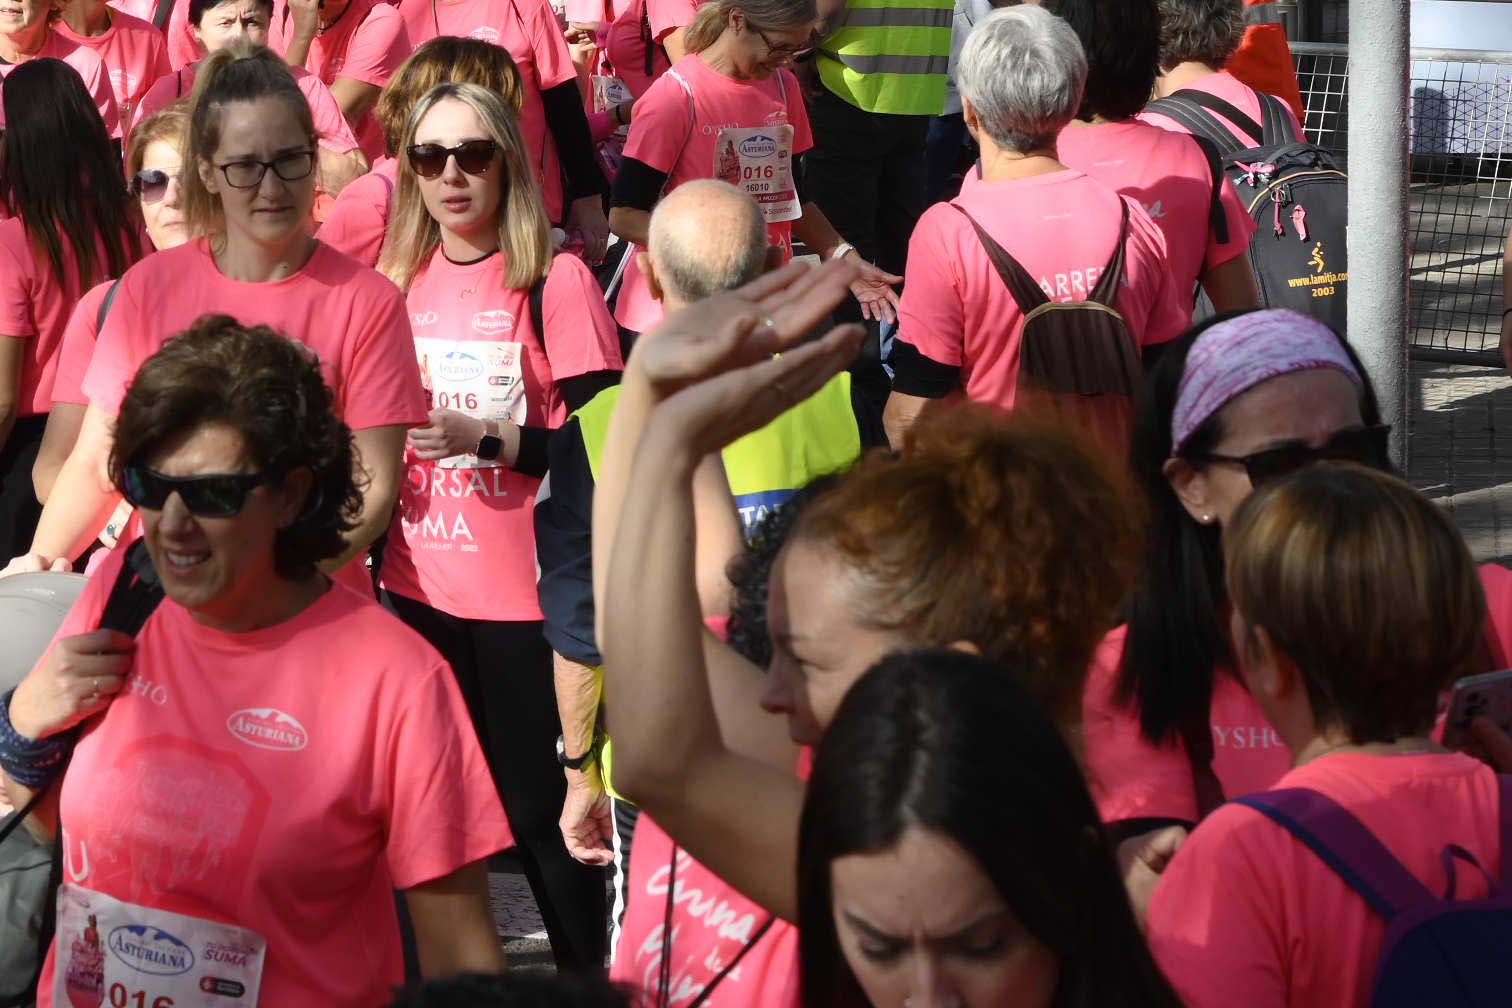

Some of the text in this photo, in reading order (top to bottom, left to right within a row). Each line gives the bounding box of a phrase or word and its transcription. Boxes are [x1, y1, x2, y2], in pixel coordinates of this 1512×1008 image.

[742, 143, 775, 153] ASTURIANA
[743, 165, 774, 180] 016
[745, 183, 770, 192] 16010
[1287, 272, 1348, 288] www.lamitja.co
[1311, 287, 1335, 297] 2003
[438, 392, 478, 410] 016
[407, 465, 508, 497] ORSAL
[401, 511, 473, 541] UMA
[235, 720, 300, 746] ASTURIANA
[1213, 725, 1285, 750] YSH
[114, 933, 186, 970] ASTURIANA
[204, 948, 248, 967] SUMA
